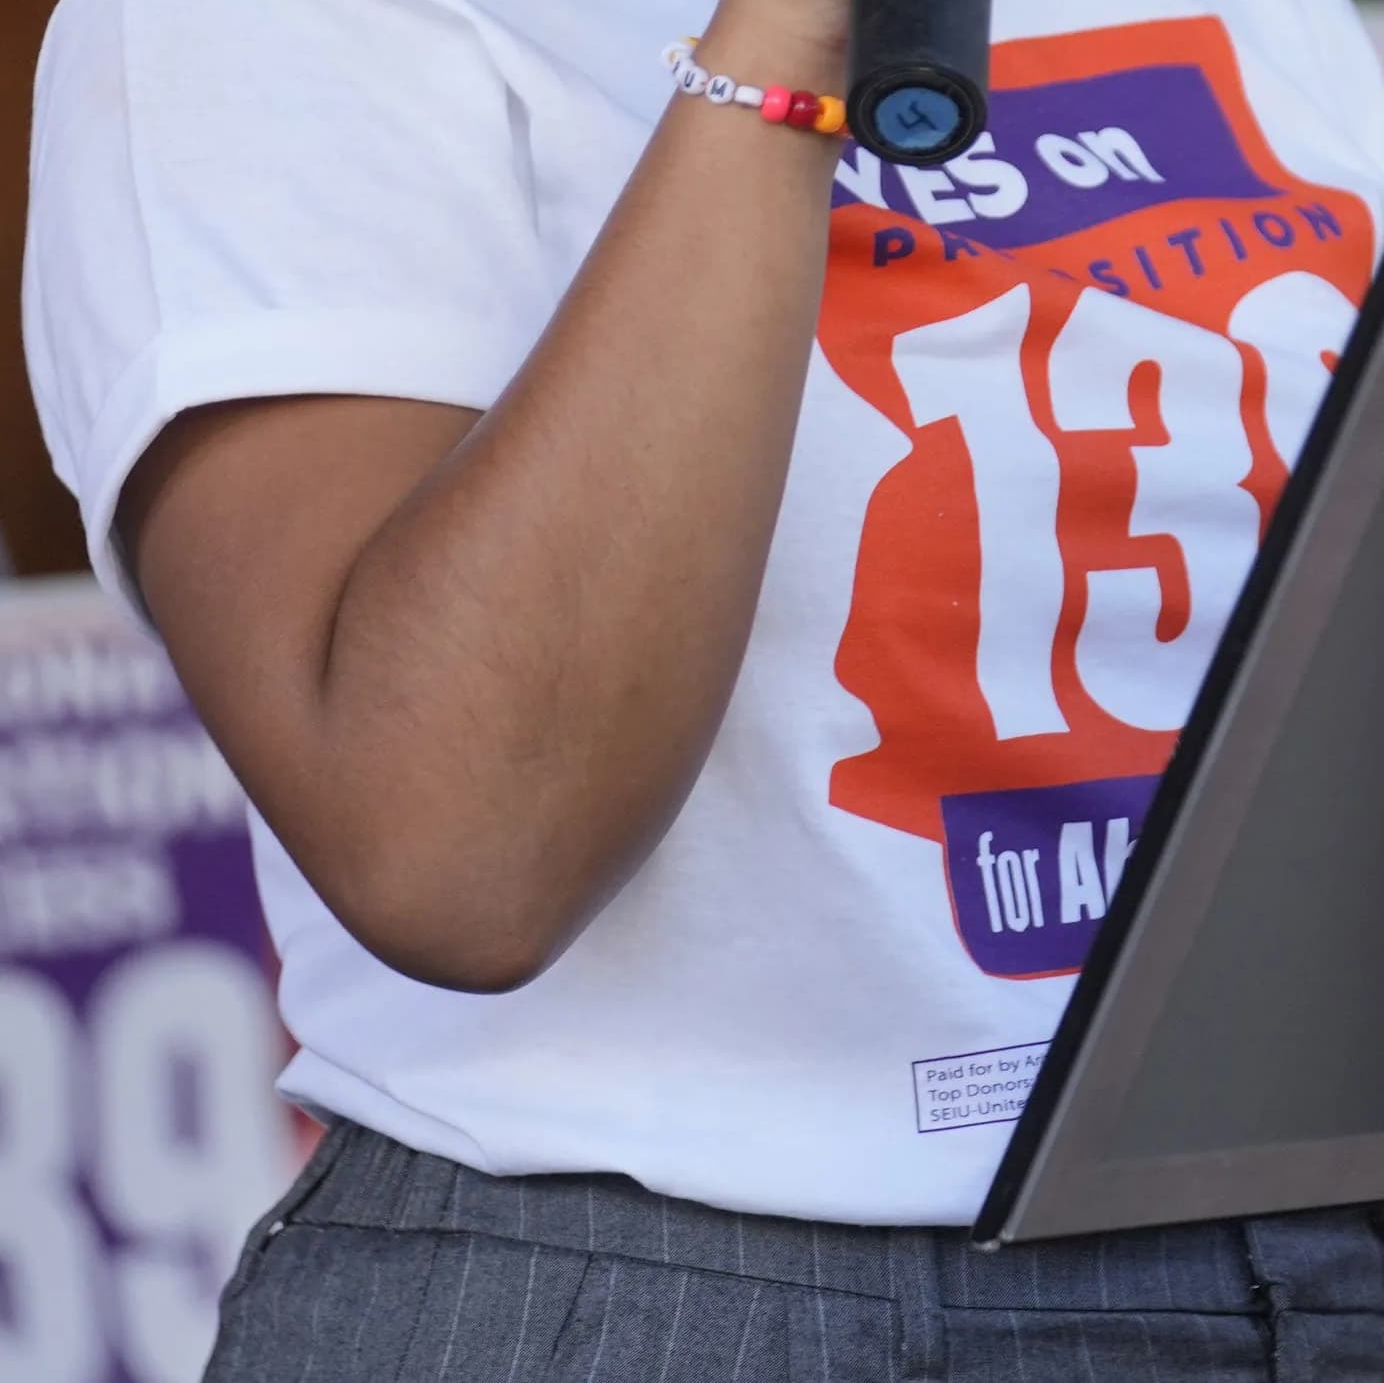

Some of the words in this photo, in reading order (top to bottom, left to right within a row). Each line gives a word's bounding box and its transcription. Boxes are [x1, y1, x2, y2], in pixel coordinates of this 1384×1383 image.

[896, 101, 937, 131] 4
[834, 131, 1029, 225] YES
[1035, 126, 1166, 189] on
[976, 831, 1044, 932] for
[926, 1066, 964, 1082] Paid
[969, 1063, 992, 1076] for
[1000, 1058, 1020, 1073] by
[928, 1088, 961, 1102] Top
